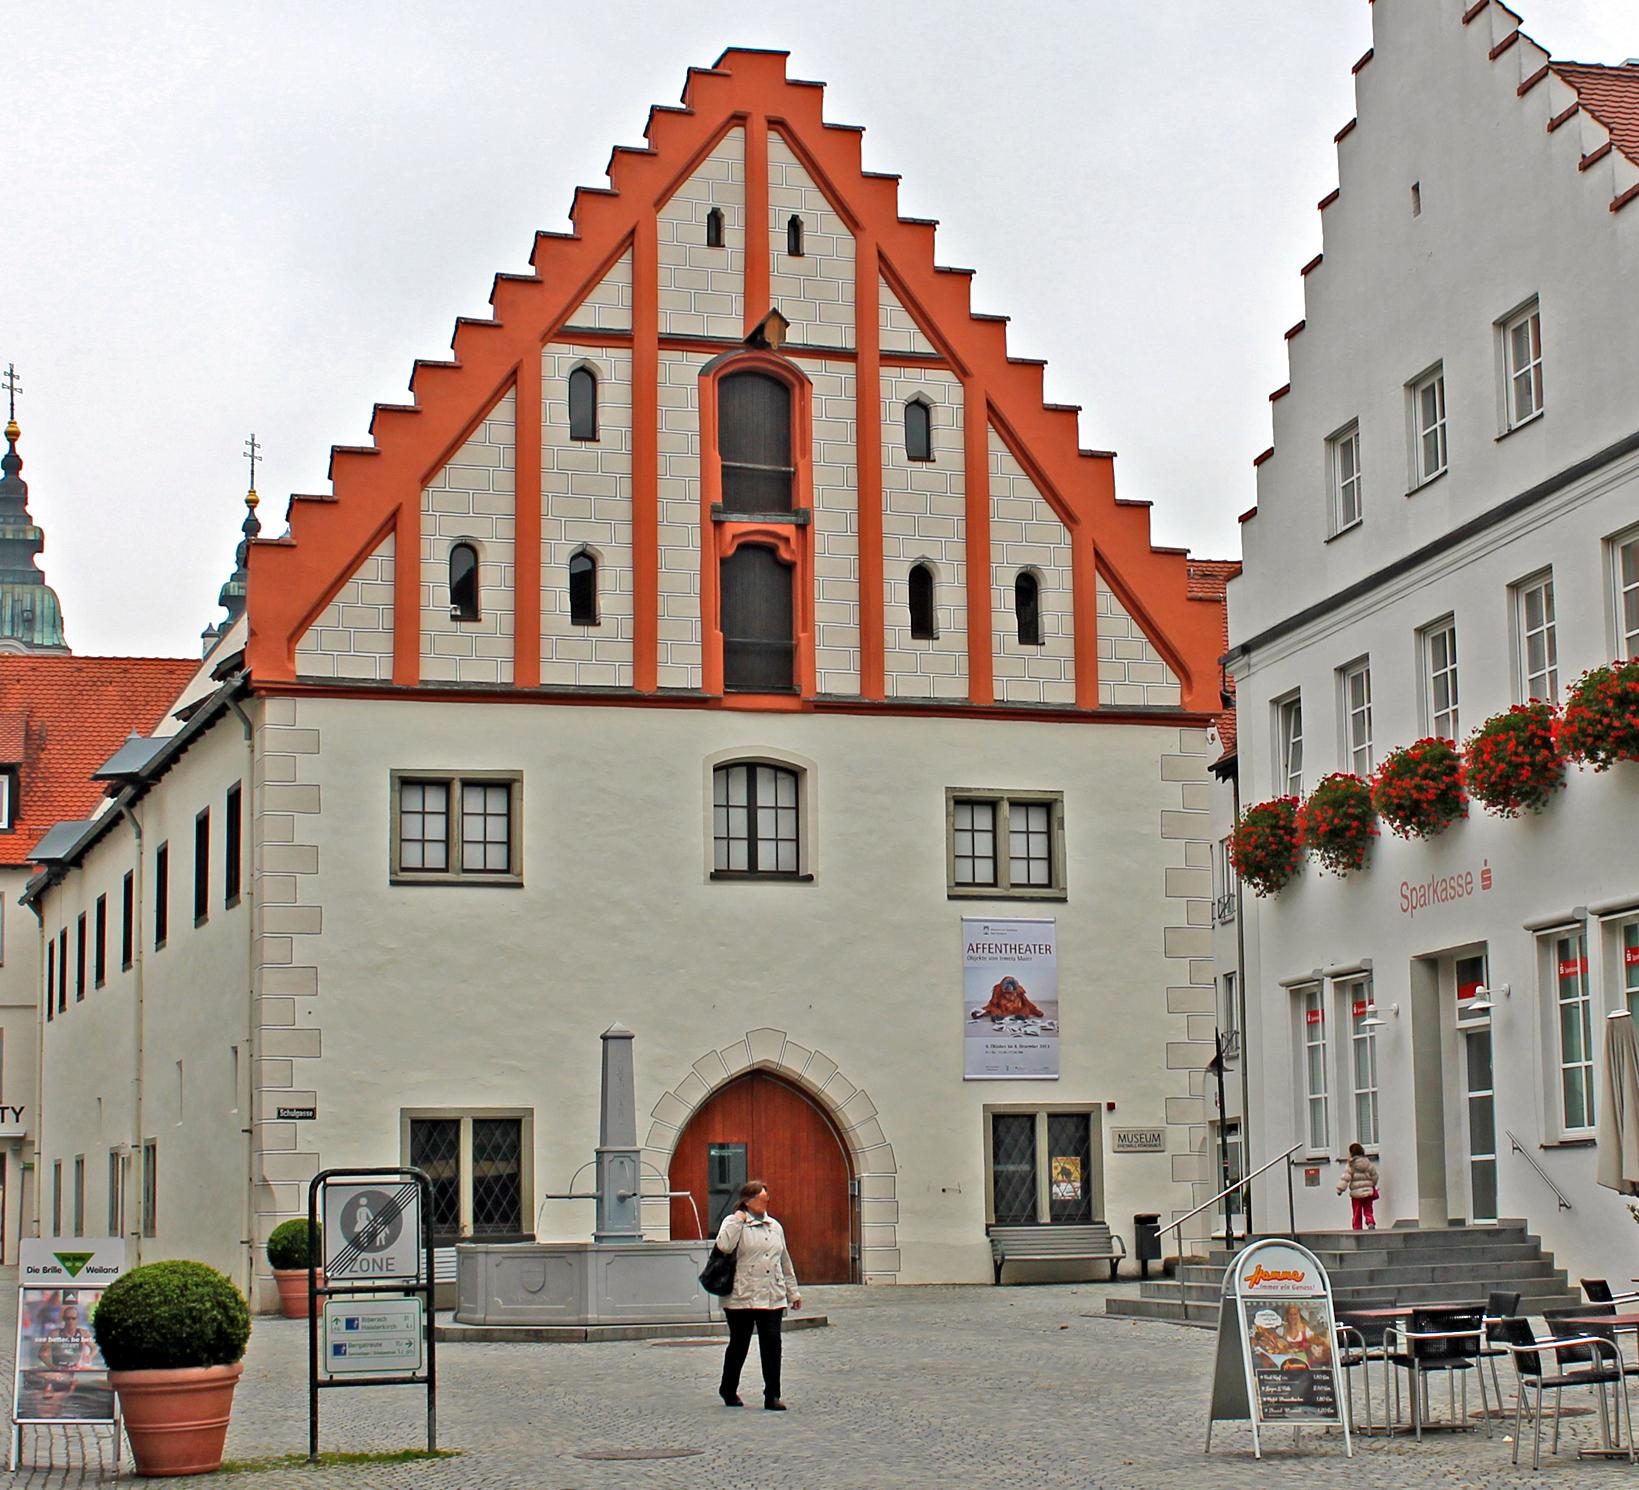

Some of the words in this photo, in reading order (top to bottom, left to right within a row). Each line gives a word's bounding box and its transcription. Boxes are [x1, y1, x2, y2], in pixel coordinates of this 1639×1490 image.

[1400, 871, 1474, 918] Sparkasse
[967, 943, 1052, 954] AFFENTHEATER
[1117, 1133, 1161, 1144] MUSEUM
[26, 1266, 40, 1274] Die
[42, 1266, 62, 1274] Brille
[86, 1266, 119, 1274] Weiland
[349, 1257, 396, 1273] ZONE
